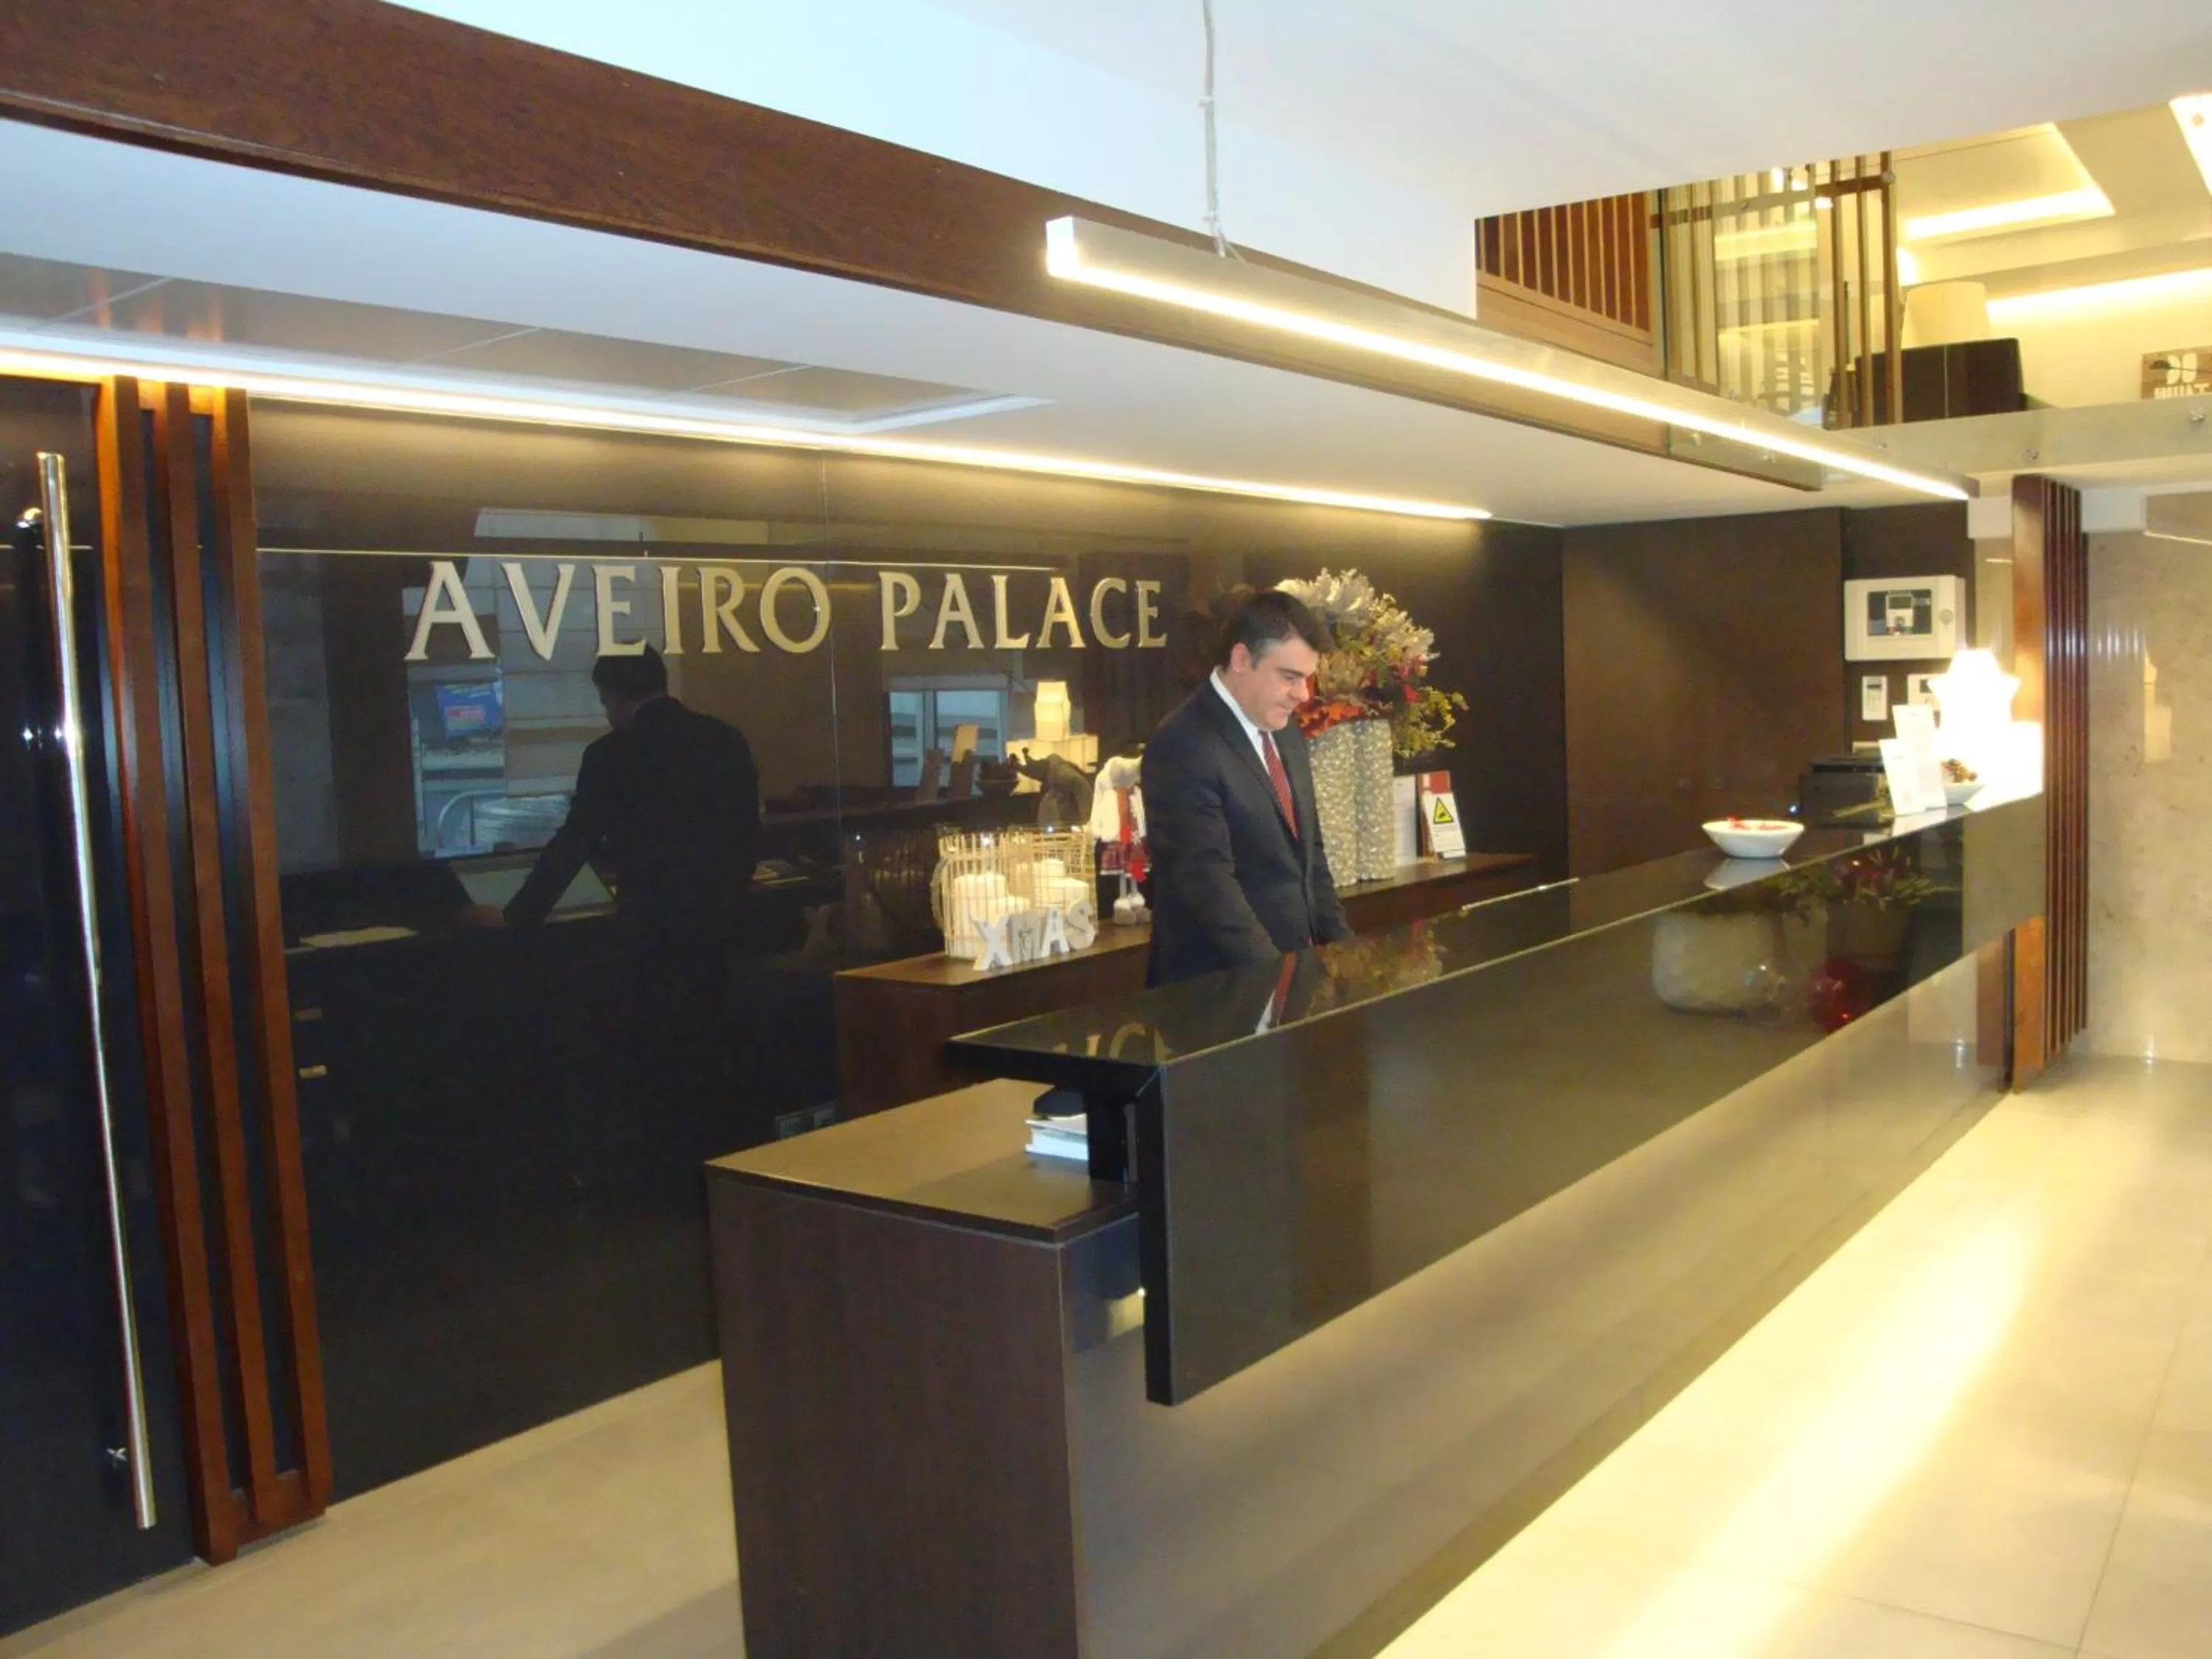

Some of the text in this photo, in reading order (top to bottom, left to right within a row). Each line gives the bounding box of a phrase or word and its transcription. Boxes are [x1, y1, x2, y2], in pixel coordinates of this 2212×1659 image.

[404, 560, 1167, 661] AVEIRO PALACE
[972, 899, 1096, 970] XMAS
